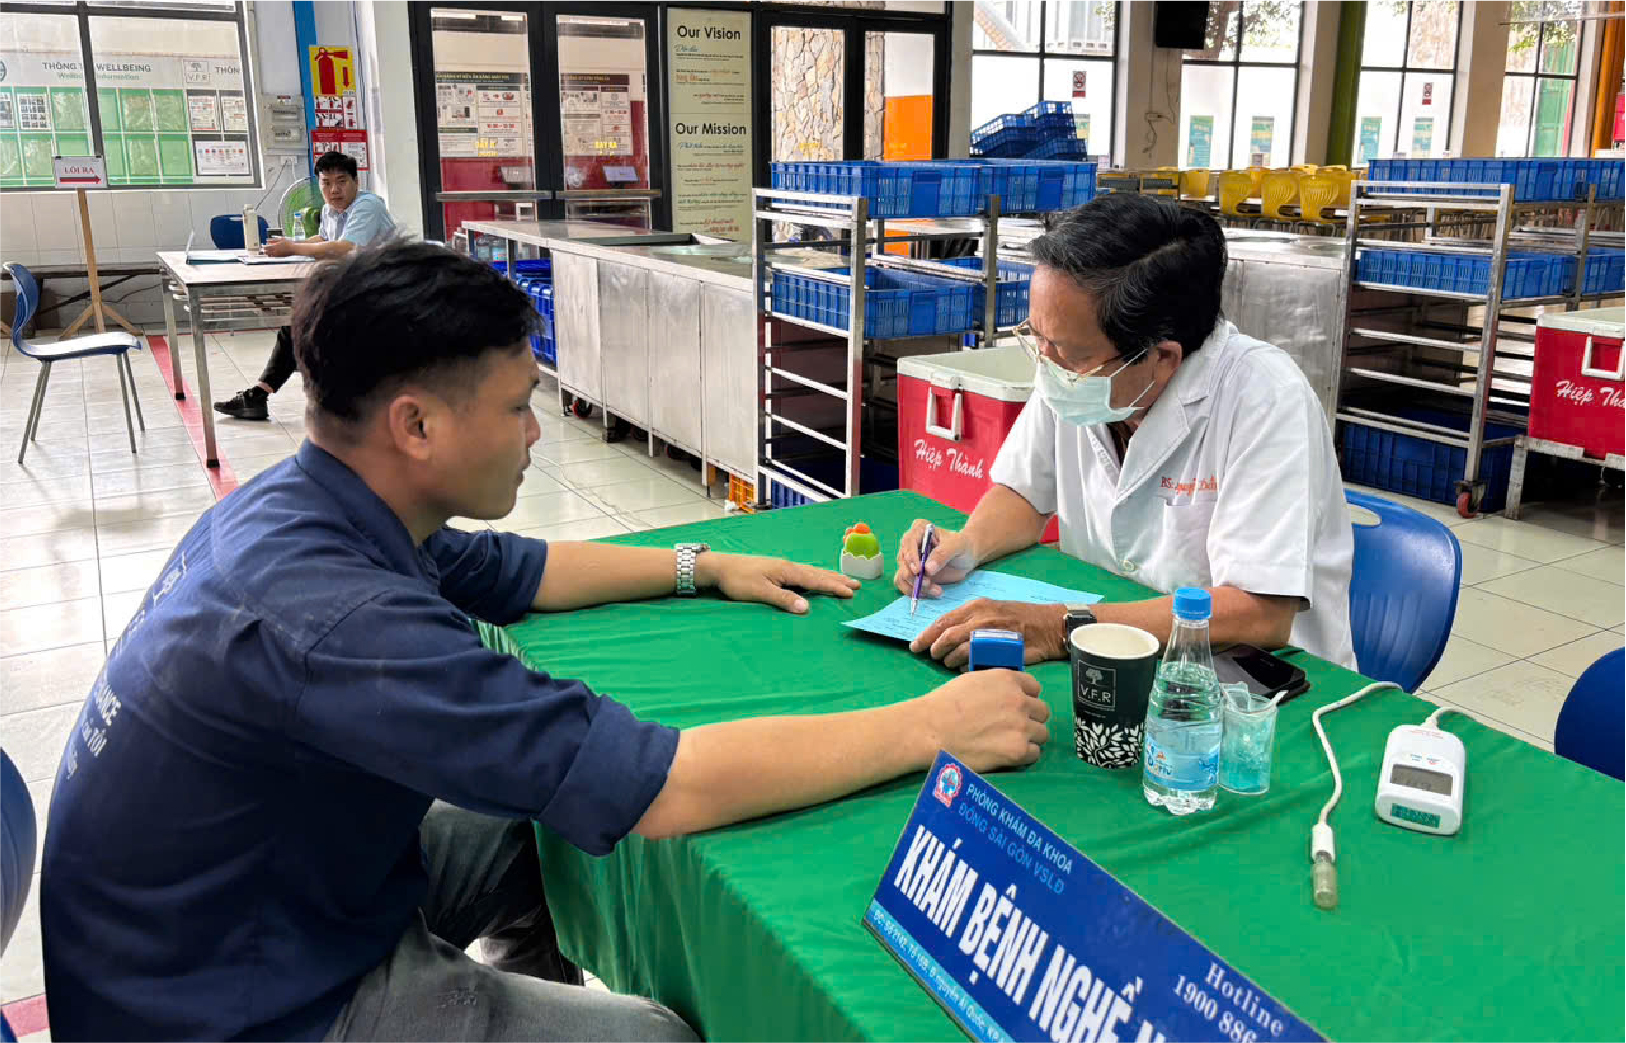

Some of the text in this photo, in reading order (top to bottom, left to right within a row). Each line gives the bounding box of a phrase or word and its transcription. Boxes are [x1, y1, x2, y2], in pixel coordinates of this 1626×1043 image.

[677, 25, 741, 40] Our Vision
[96, 63, 152, 73] WELLBEING
[215, 66, 240, 74] THÔN
[675, 122, 747, 135] Our Mission
[914, 439, 984, 479] Hiệp Thành
[1080, 684, 1111, 703] V.F.R
[966, 783, 1073, 875] PHÒNG KHÁM ĐA KHOA
[893, 824, 1144, 1043] KHÁM BỆNH NGHỀ
[1173, 975, 1219, 1020] 1900
[1205, 962, 1284, 1037] Hotline
